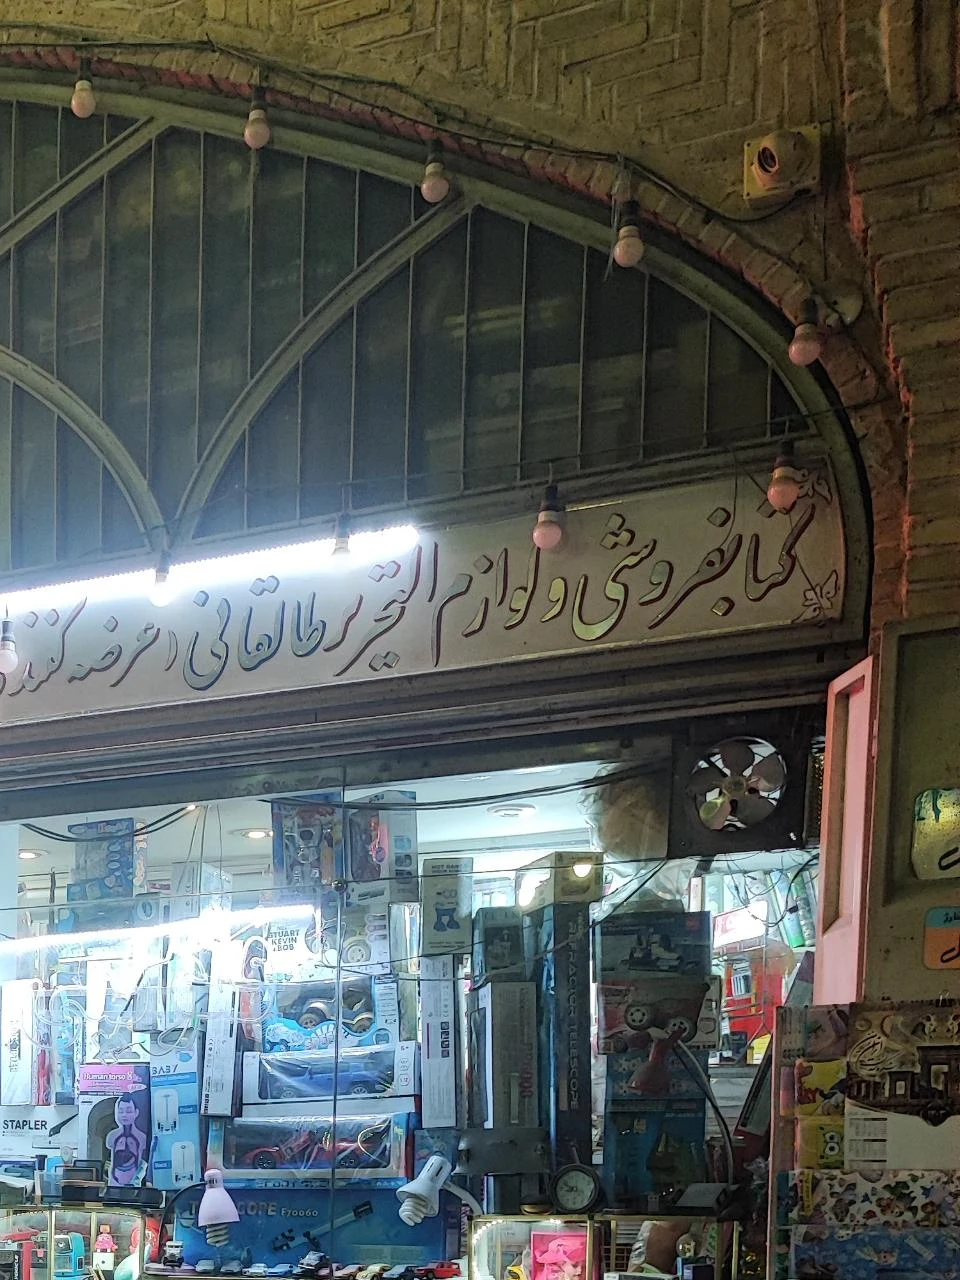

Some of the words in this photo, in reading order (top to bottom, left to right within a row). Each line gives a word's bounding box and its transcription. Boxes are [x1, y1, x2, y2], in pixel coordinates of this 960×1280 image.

[434, 541, 541, 668] لوازم
[182, 574, 327, 692] طالقانی
[267, 928, 300, 938] STUART
[271, 936, 297, 946] KEVIN
[109, 1072, 126, 1080] torso
[2, 1119, 48, 1131] STAPLER
[280, 1207, 319, 1219] F70060
